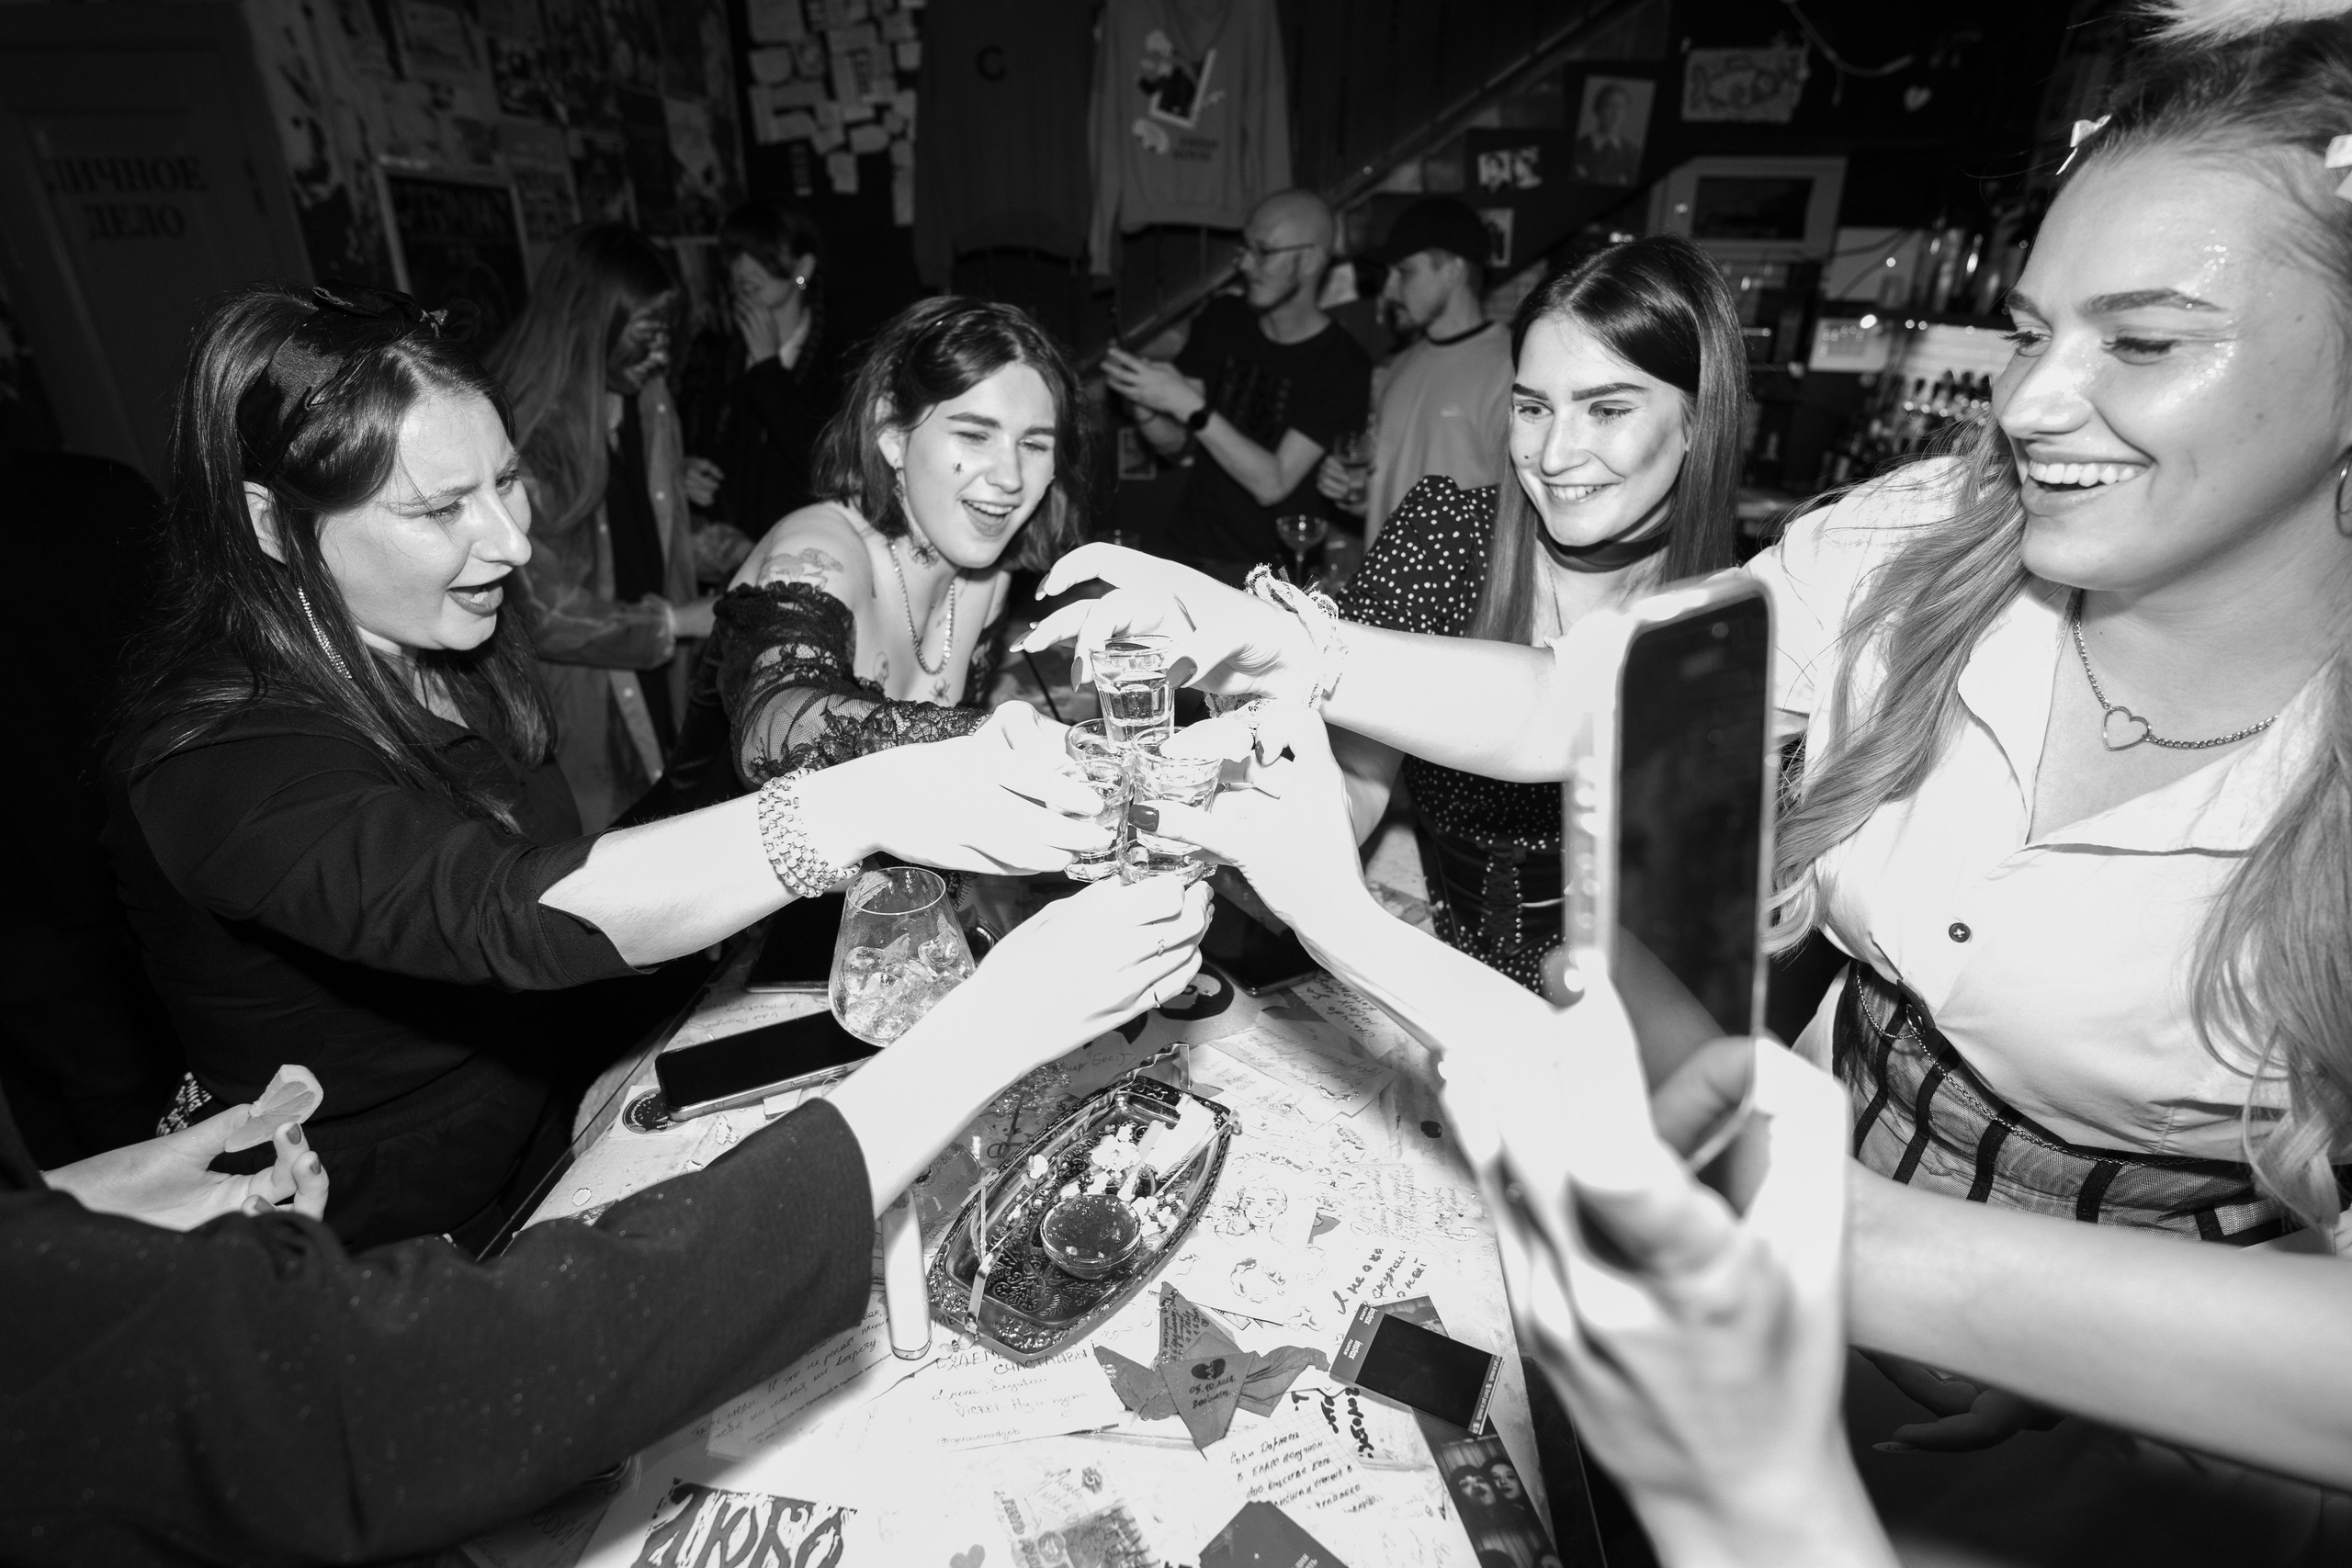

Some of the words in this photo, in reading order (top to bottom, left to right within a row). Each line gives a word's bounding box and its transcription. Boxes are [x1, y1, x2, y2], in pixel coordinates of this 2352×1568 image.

[83, 201, 186, 241] ДЕЛО
[1364, 1307, 1378, 1325] instax
[1348, 1339, 1363, 1360] instax
